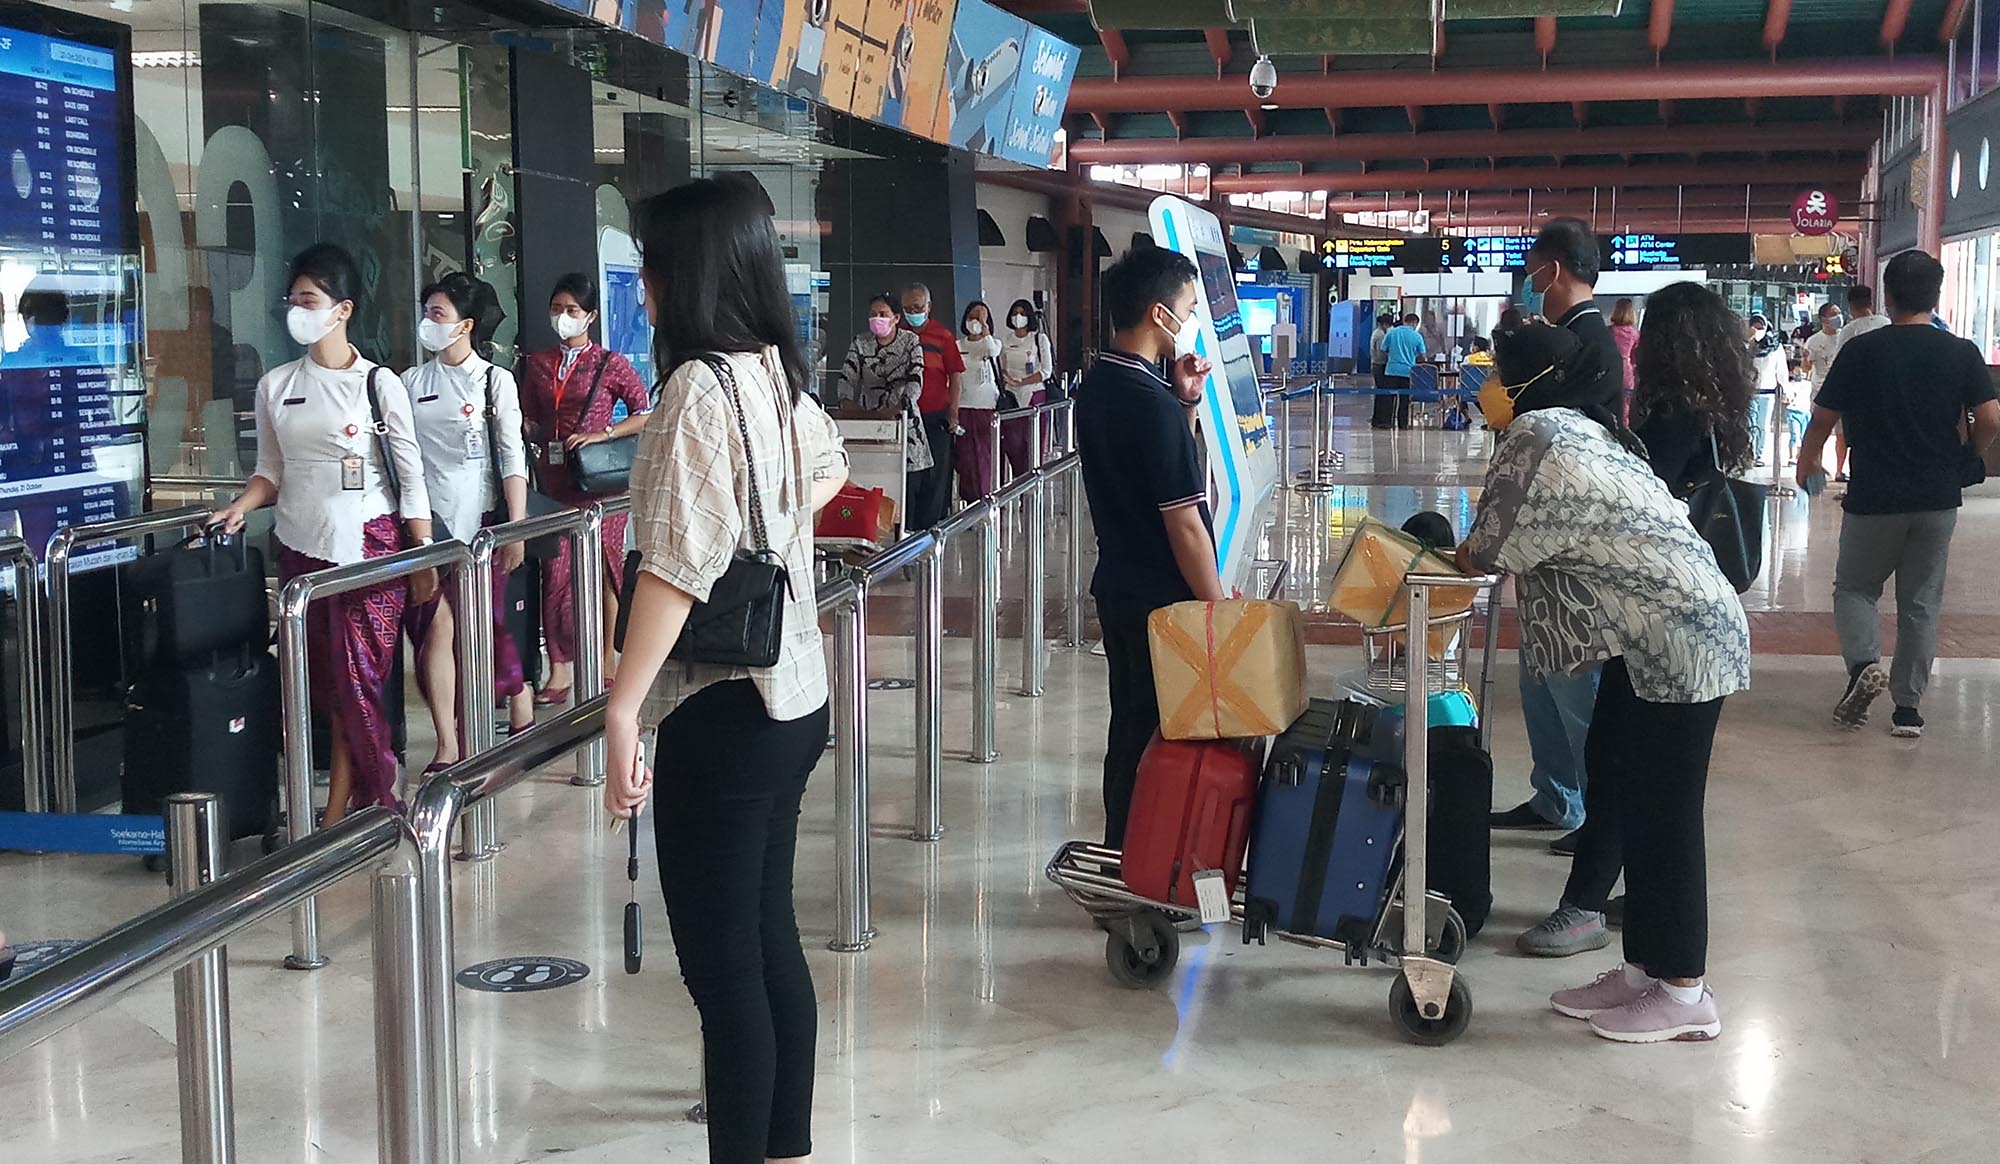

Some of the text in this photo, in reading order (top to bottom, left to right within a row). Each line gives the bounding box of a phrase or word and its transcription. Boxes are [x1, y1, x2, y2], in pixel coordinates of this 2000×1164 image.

[1796, 208, 1833, 228] SOLARIA
[1441, 239, 1450, 250] 5
[1441, 254, 1450, 265] 5
